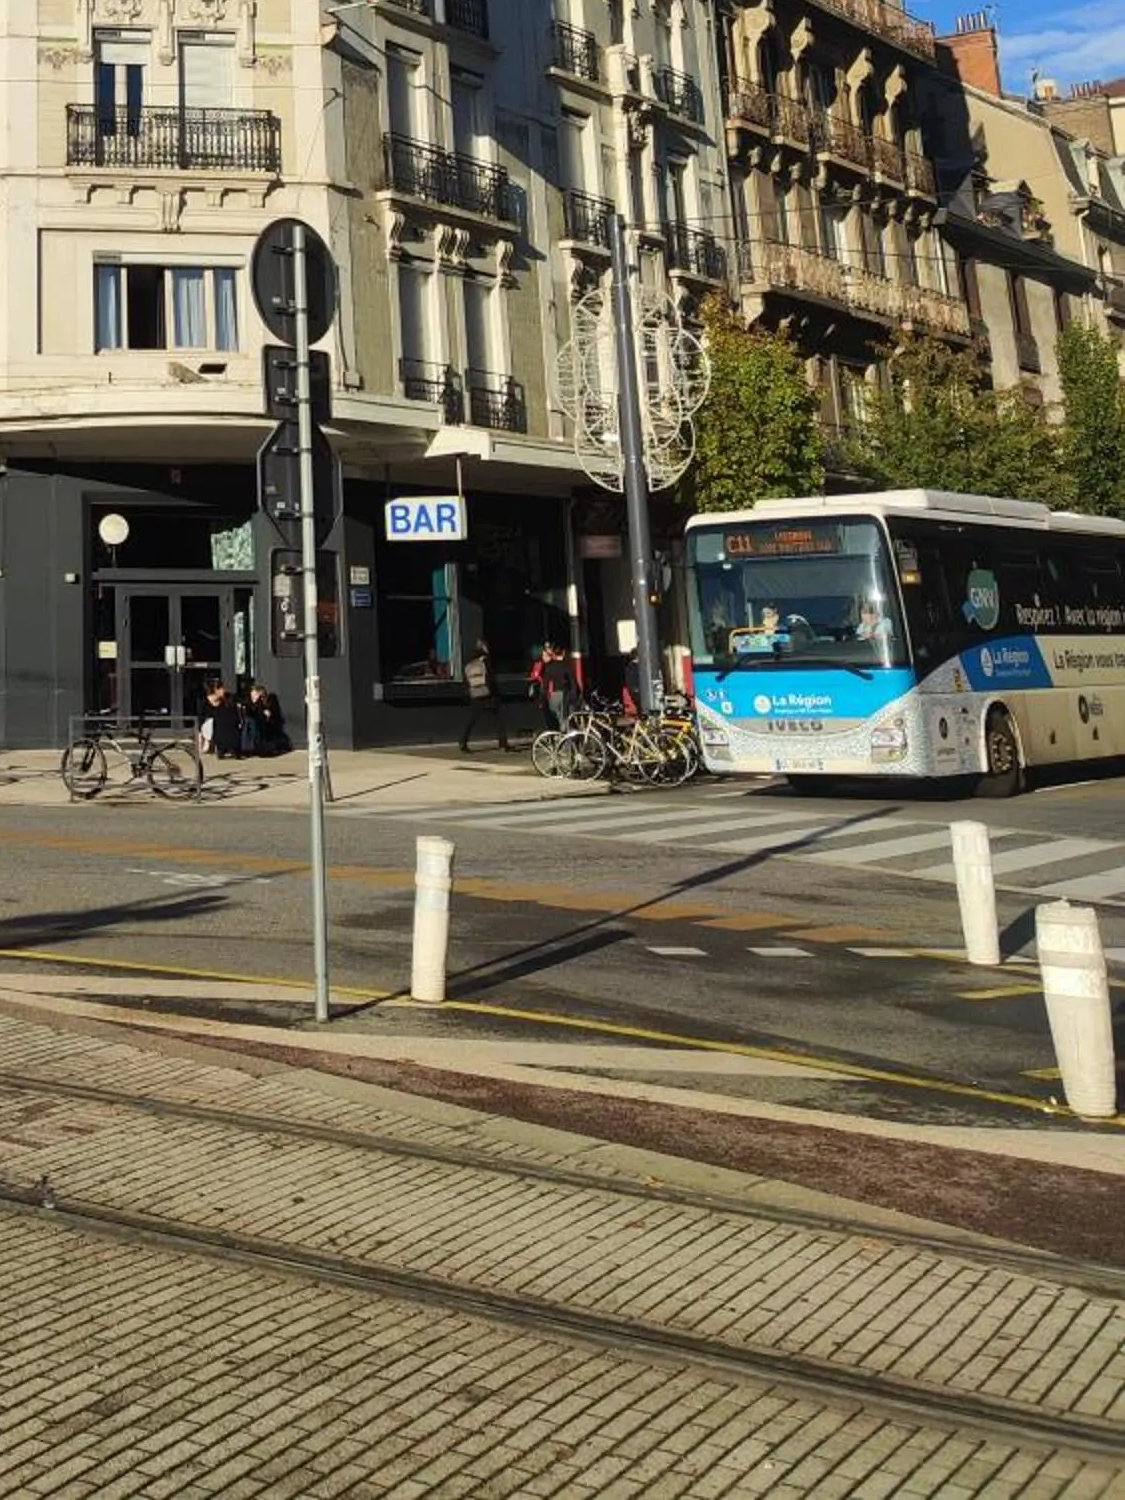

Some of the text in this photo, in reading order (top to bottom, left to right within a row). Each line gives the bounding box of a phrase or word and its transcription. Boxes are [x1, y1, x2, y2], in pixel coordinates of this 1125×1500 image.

[390, 503, 457, 533] BAR
[772, 693, 832, 709] La Région
[768, 719, 824, 732] IVECO
